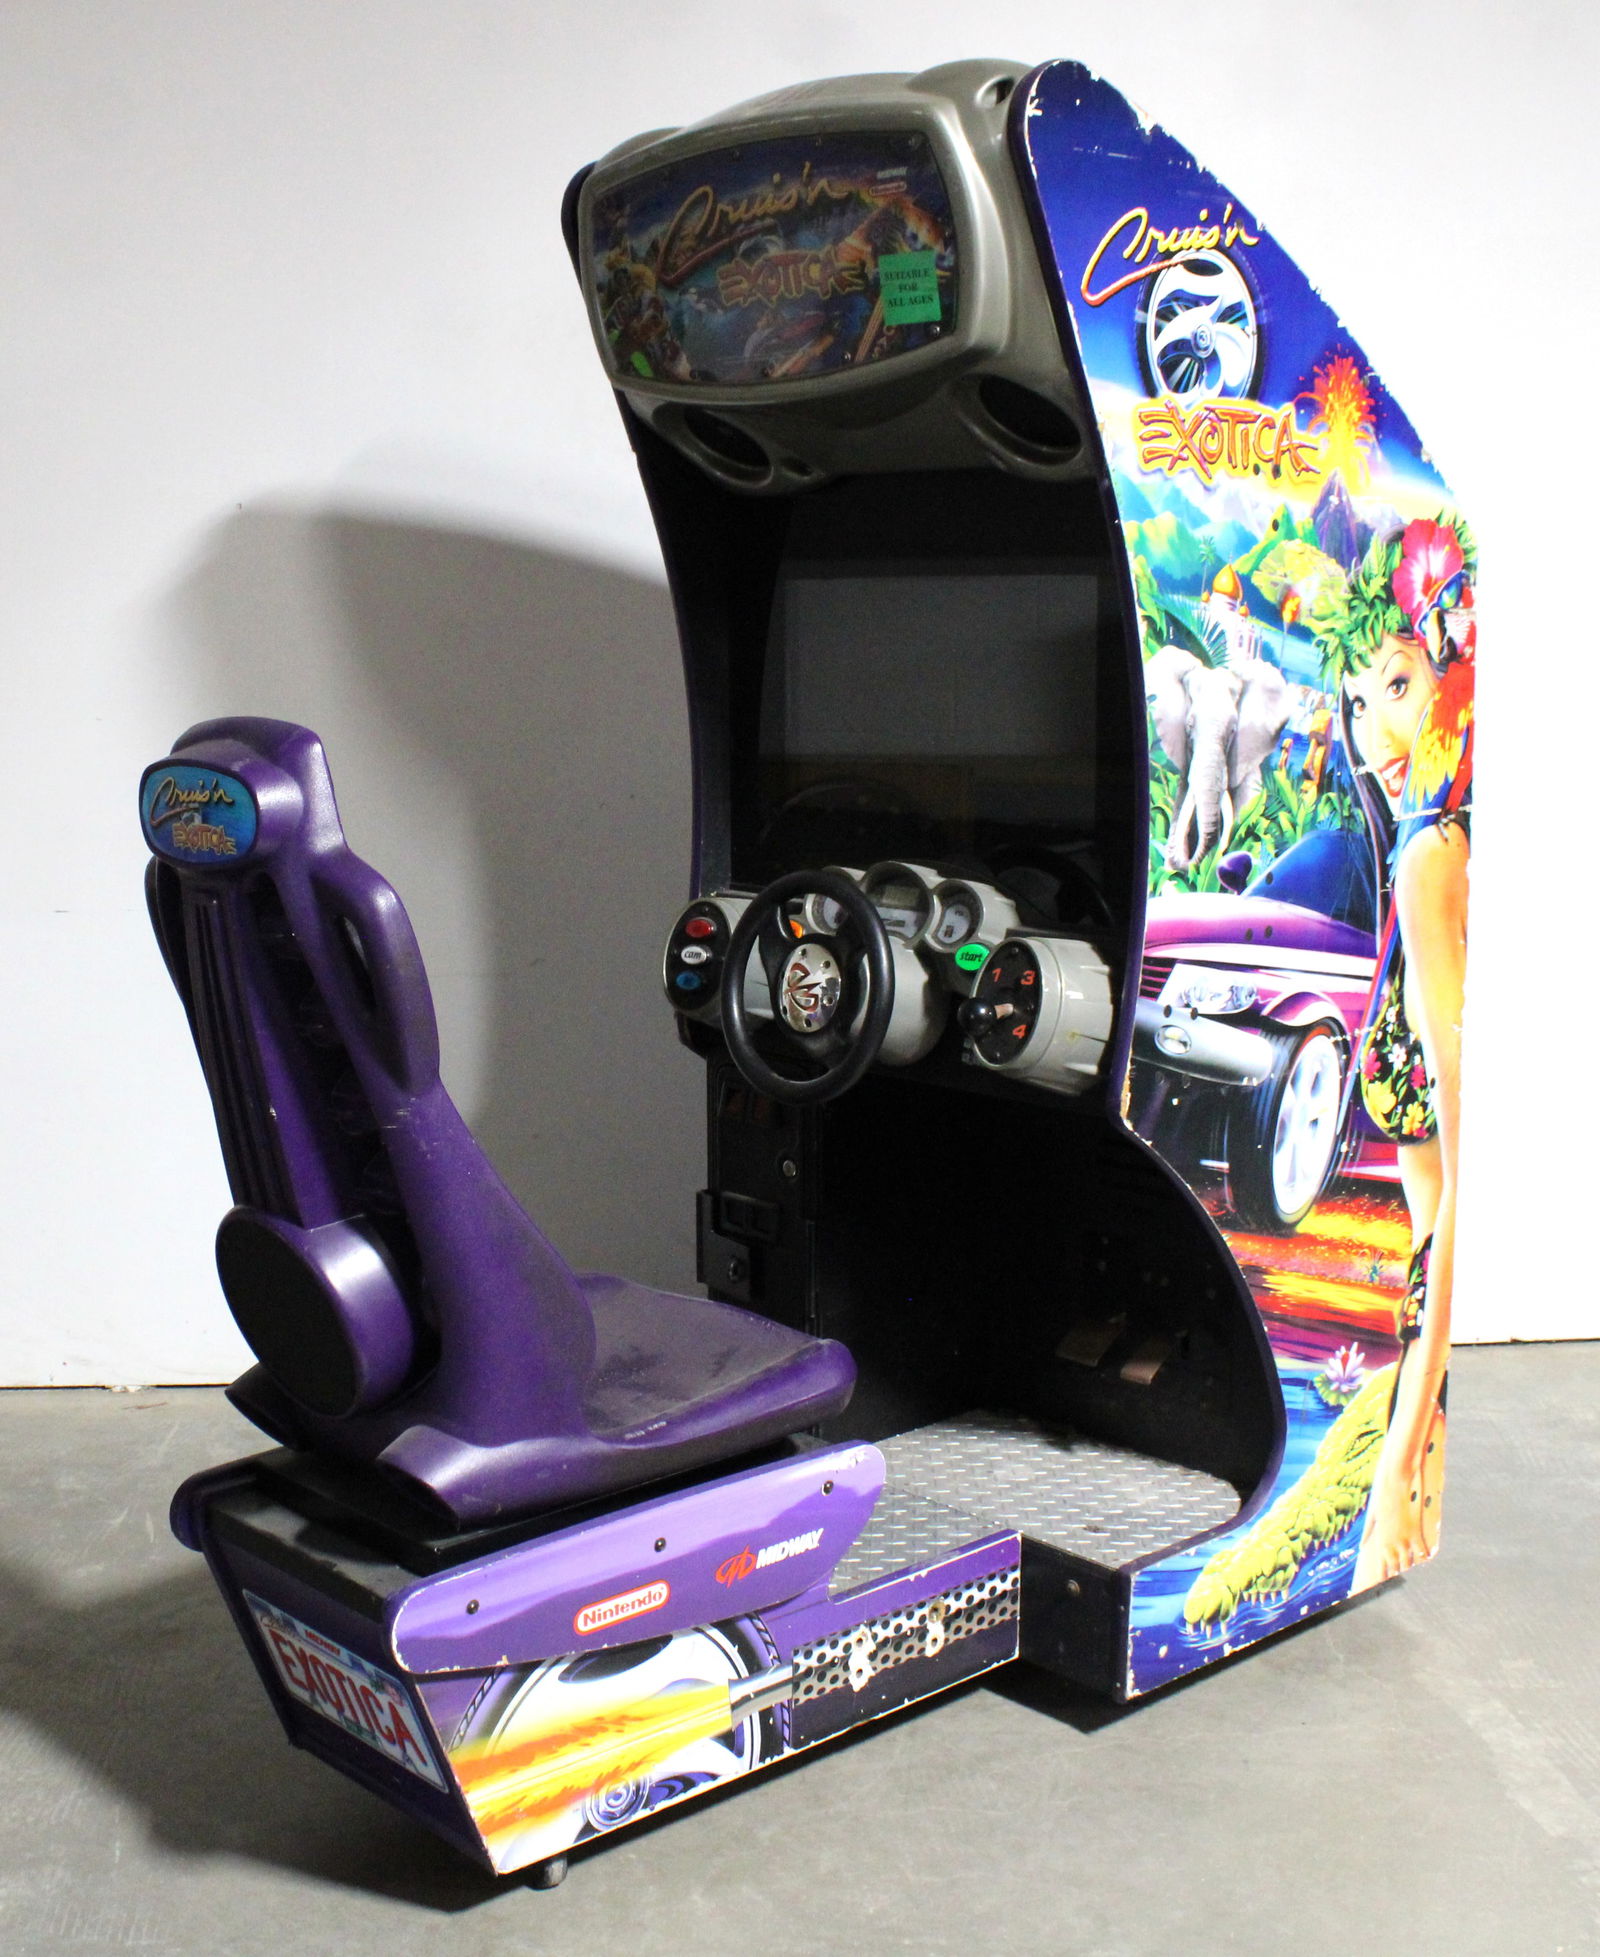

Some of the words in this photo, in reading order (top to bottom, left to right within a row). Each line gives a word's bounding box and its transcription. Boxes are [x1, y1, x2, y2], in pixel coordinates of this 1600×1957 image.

[884, 267, 930, 281] SUITABLE
[898, 283, 919, 292] FOR
[887, 296, 906, 308] ALL
[908, 294, 934, 306] AGES
[1138, 400, 1321, 480] EXOTICA
[684, 950, 702, 960] cam
[959, 951, 984, 963] start
[992, 967, 1002, 983] 1
[1020, 970, 1036, 985] 3
[1012, 1024, 1027, 1039] 4
[756, 1527, 824, 1569] MIDWAY
[583, 1590, 662, 1628] Nintendo
[268, 1628, 428, 1767] EXOTICA
